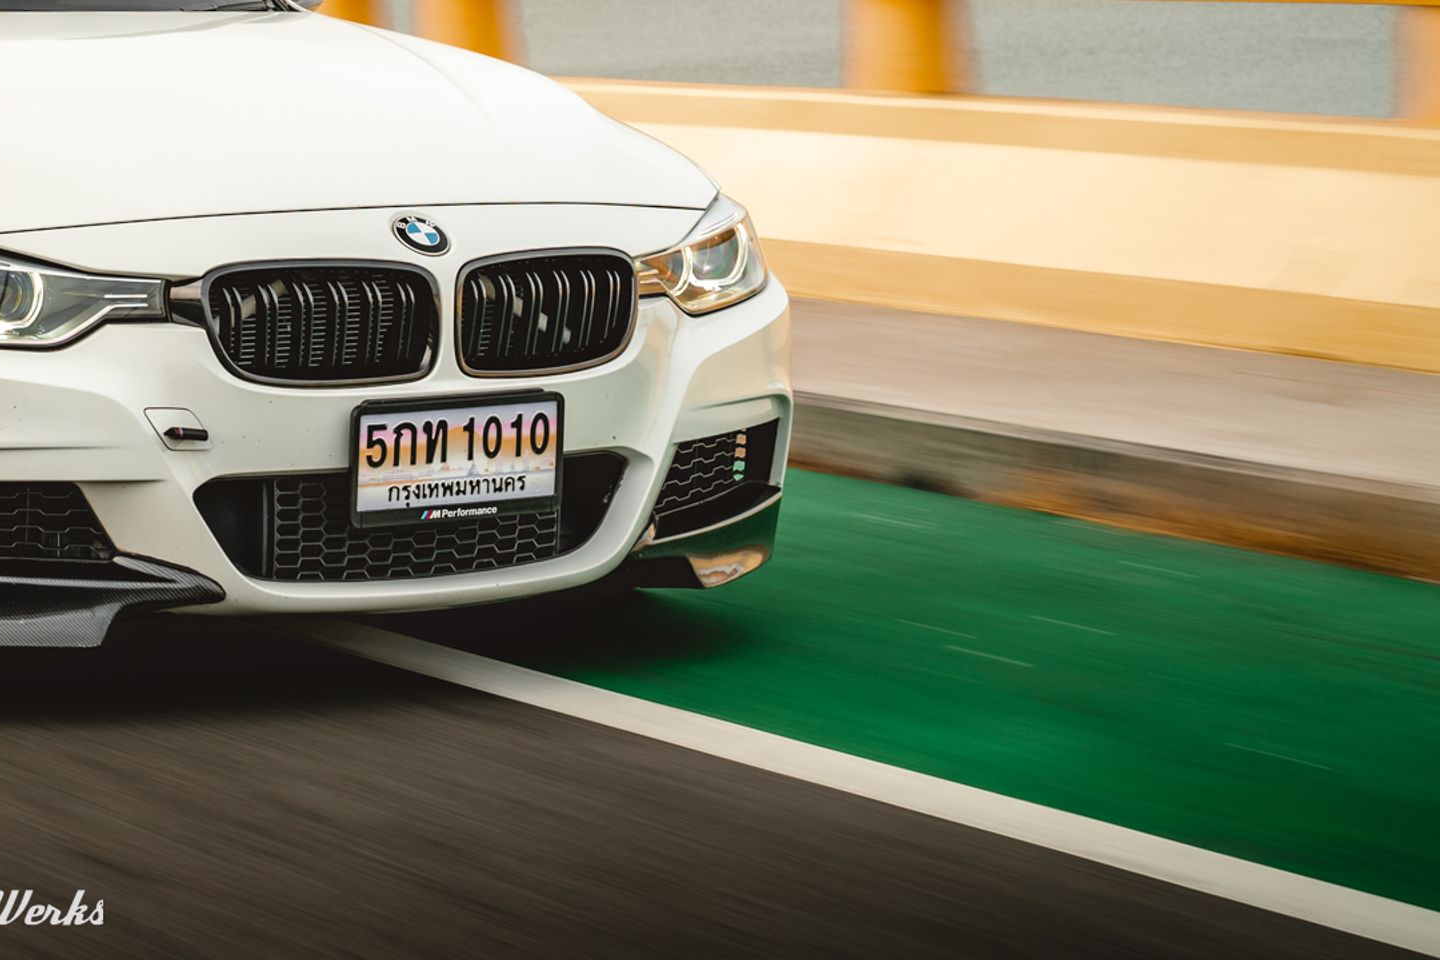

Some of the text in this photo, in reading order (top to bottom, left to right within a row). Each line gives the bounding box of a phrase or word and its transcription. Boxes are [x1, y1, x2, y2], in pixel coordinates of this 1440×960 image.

[365, 412, 550, 469] 5กท 1010
[387, 474, 527, 508] กรุงเทพมหานคร
[441, 506, 498, 519] Performance
